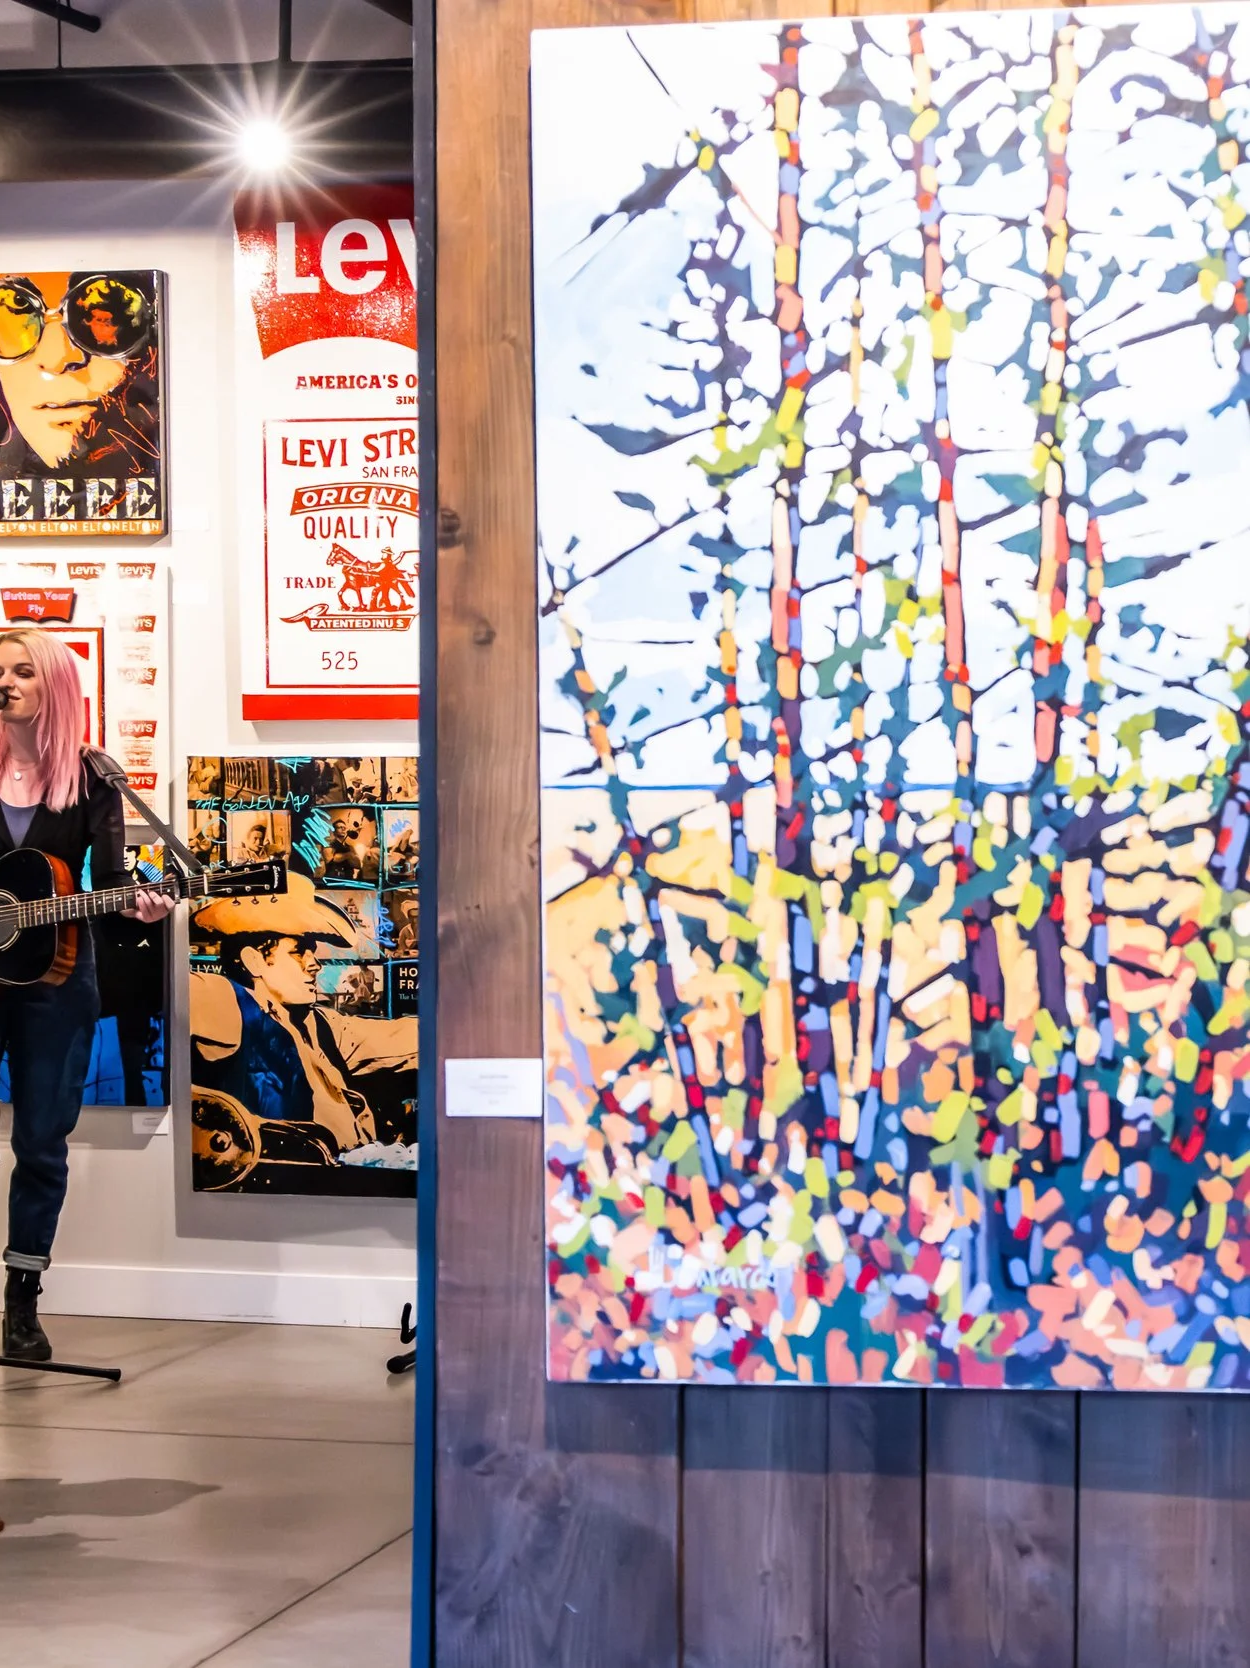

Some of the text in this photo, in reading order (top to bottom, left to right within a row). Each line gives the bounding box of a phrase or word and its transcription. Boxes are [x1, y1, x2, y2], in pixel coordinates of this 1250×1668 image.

[296, 374, 399, 390] AMERICA'S
[396, 396, 419, 405] SIN
[281, 436, 348, 467] LEVI
[362, 465, 419, 478] SAN FRA
[301, 487, 418, 510] ORIGINA
[0, 522, 36, 533] ELTON
[40, 522, 78, 532] ELTON
[83, 521, 120, 532] ELTON
[122, 521, 159, 532] ELTON
[303, 516, 398, 540] QUALITY
[284, 576, 337, 589] TRADE
[2, 590, 71, 600] Button Your
[28, 603, 46, 616] Fly
[321, 651, 358, 671] 525
[127, 776, 154, 785] evi's
[399, 967, 419, 977] HO
